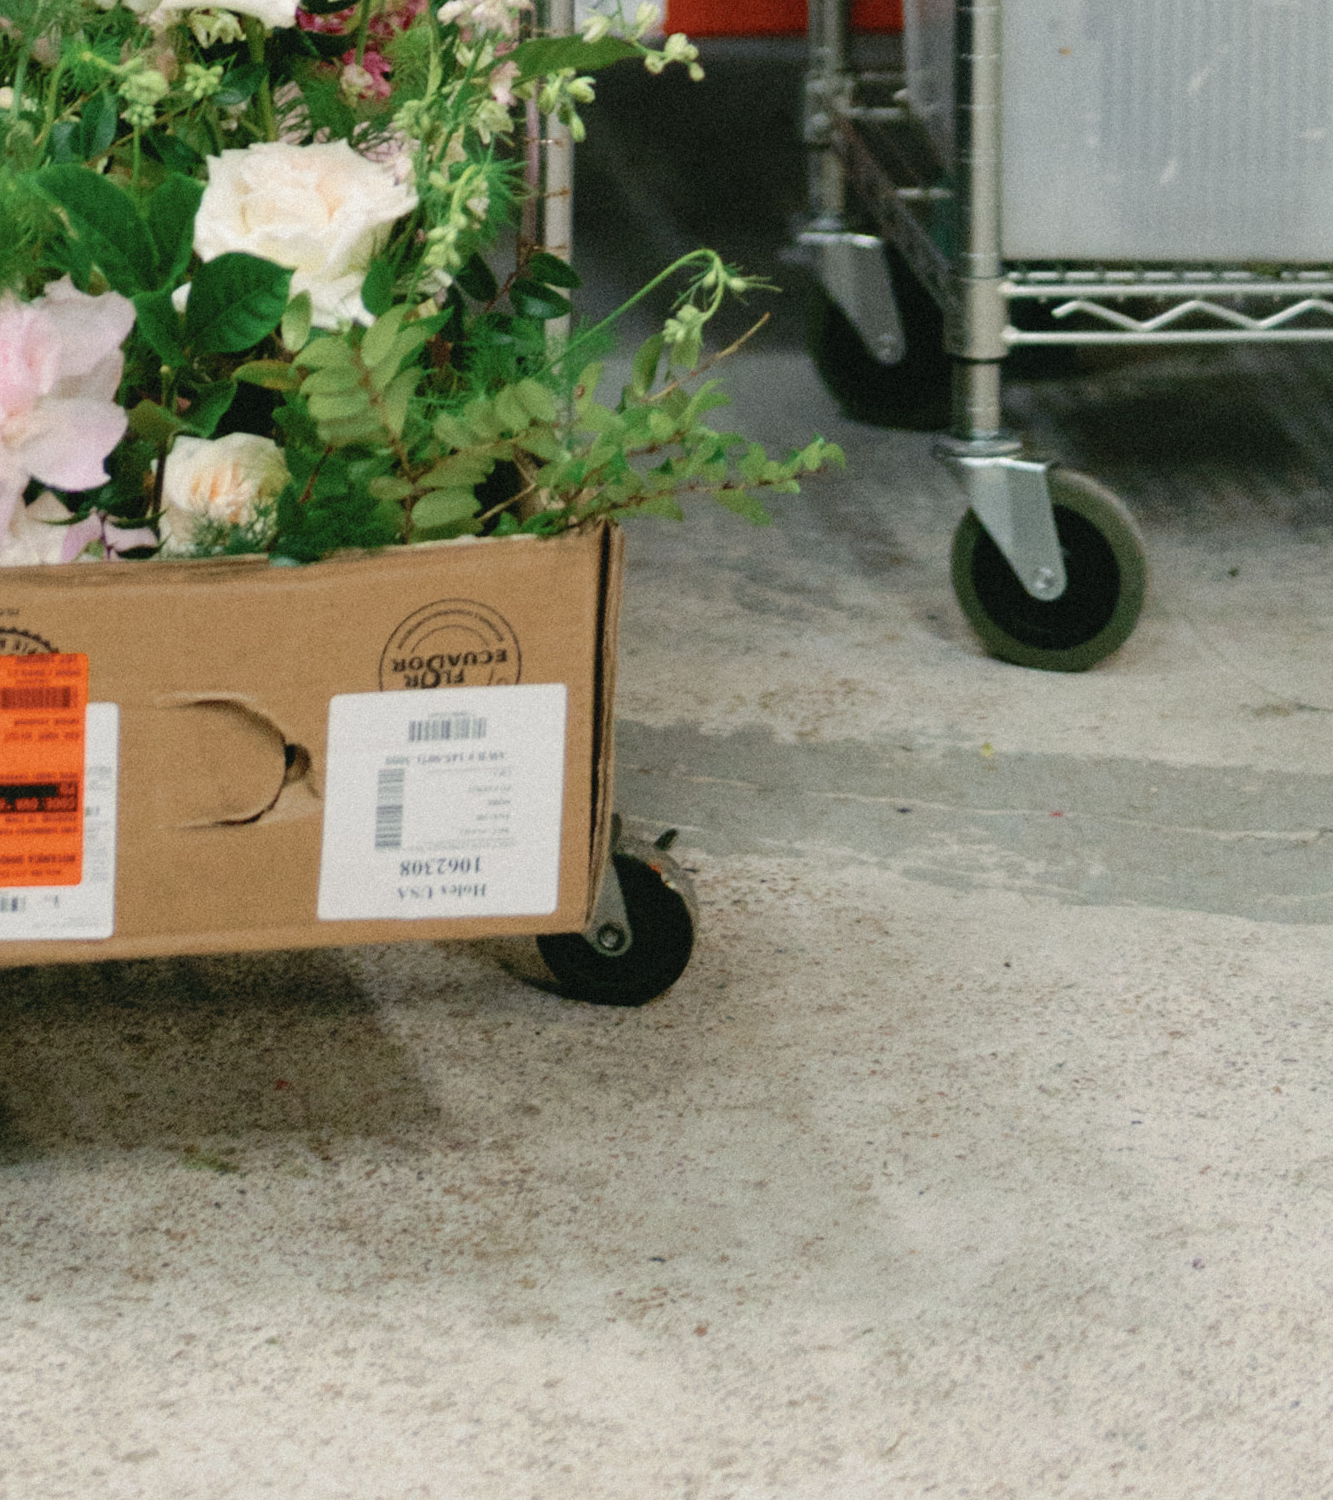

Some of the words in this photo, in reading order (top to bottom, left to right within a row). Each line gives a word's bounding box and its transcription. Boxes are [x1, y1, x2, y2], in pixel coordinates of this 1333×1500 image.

[391, 649, 509, 673] ECUADOR
[398, 855, 483, 877] 1062308
[395, 885, 434, 901] USA
[440, 882, 488, 899] Holex
